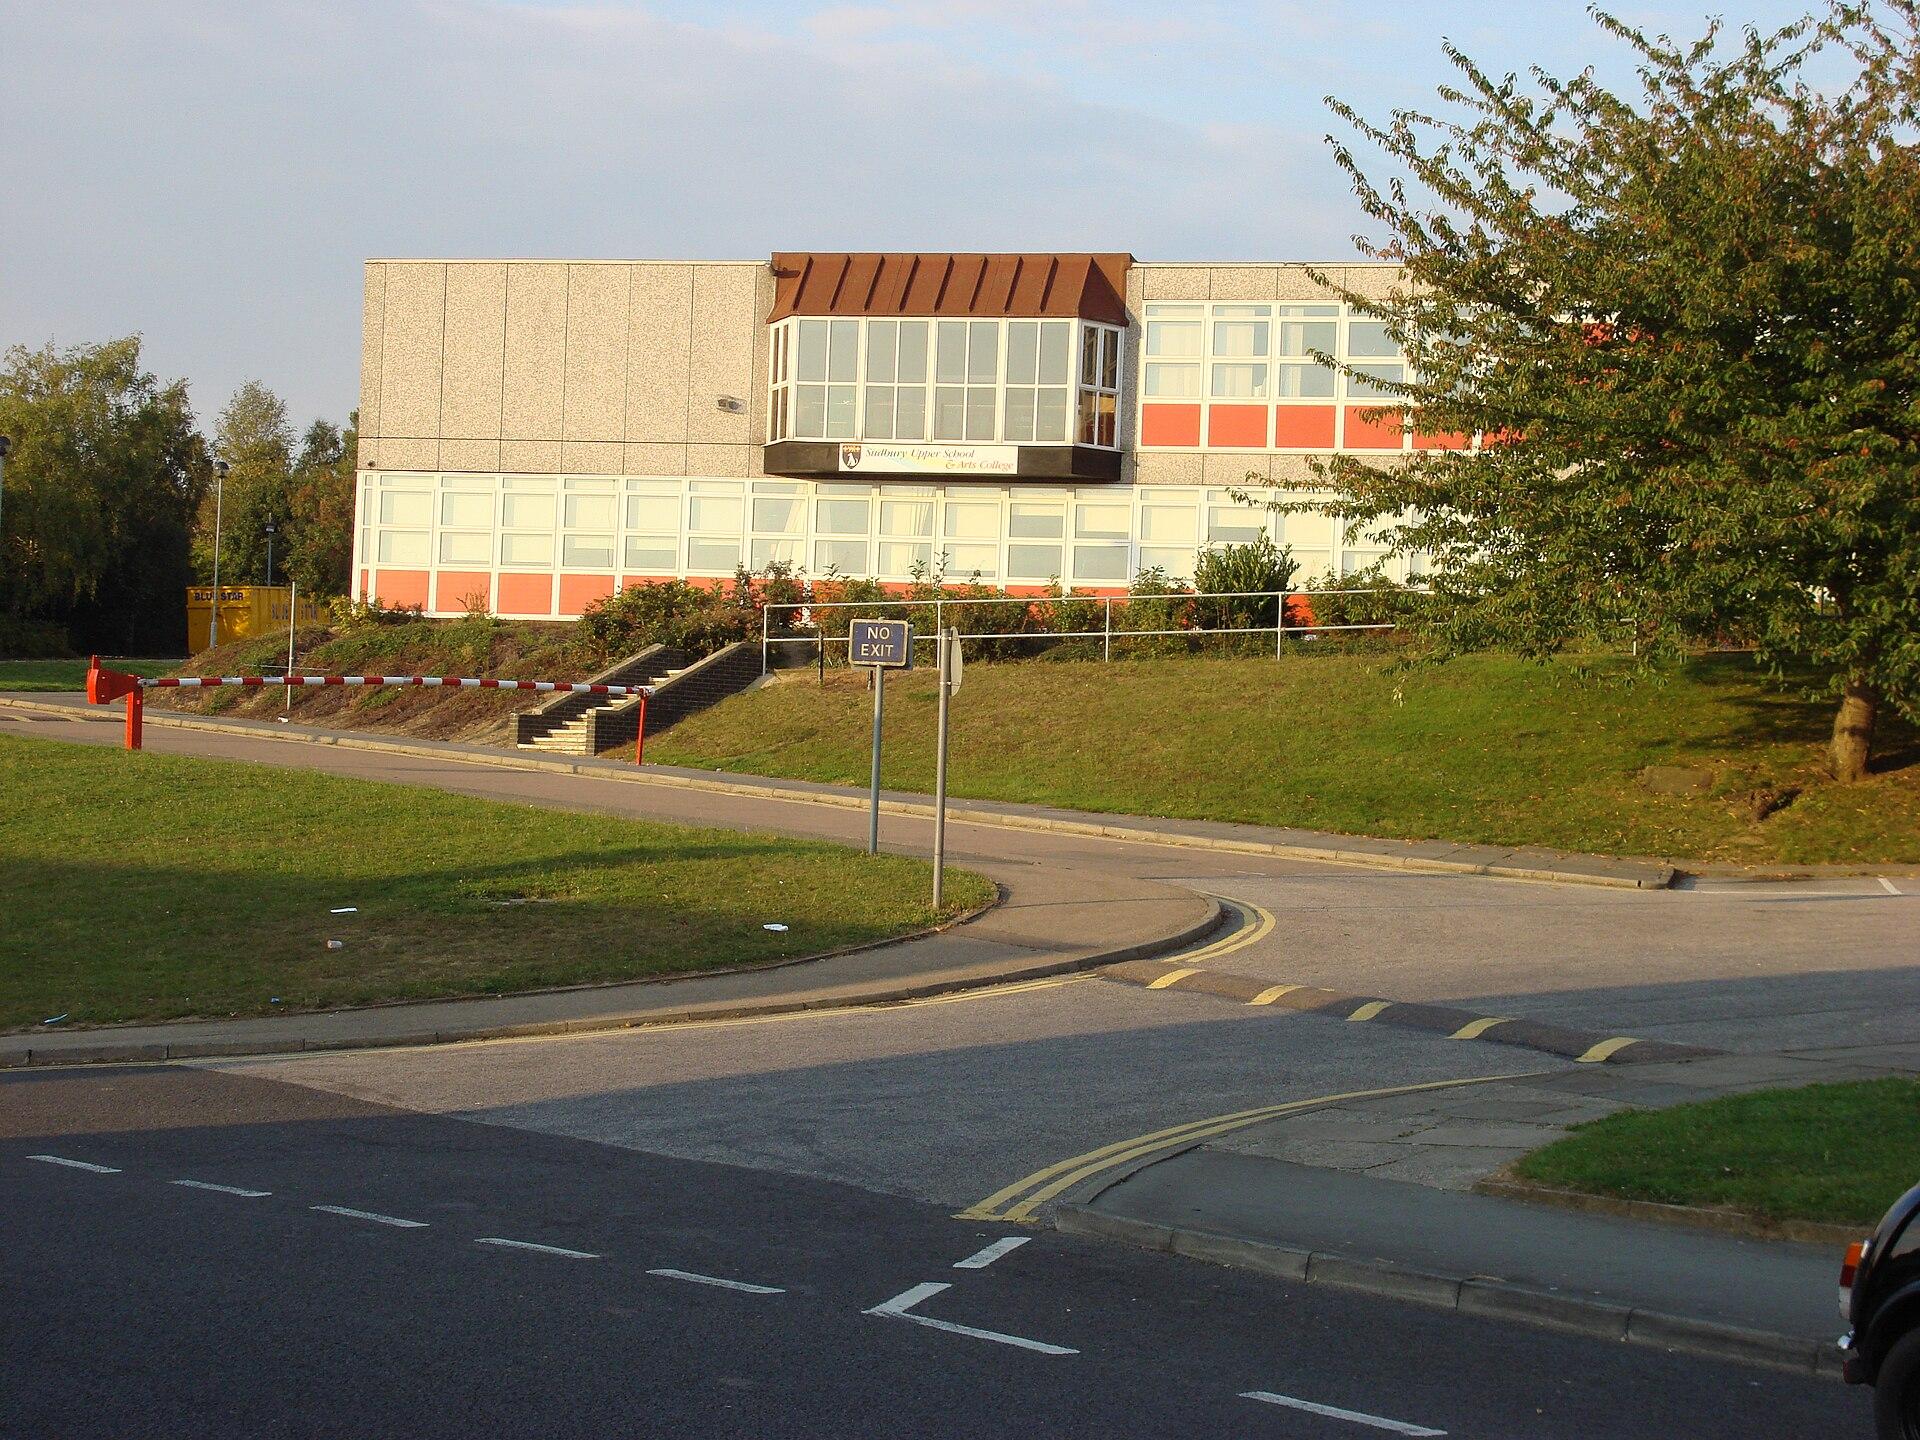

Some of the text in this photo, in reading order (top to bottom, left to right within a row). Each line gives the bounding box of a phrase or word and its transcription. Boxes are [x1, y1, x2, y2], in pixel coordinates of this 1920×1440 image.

[866, 448, 975, 460] Sudbury Upper School
[945, 460, 1014, 472] & Arts College
[220, 592, 244, 601] STAR
[867, 626, 890, 640] NO
[861, 643, 894, 657] EXIT
